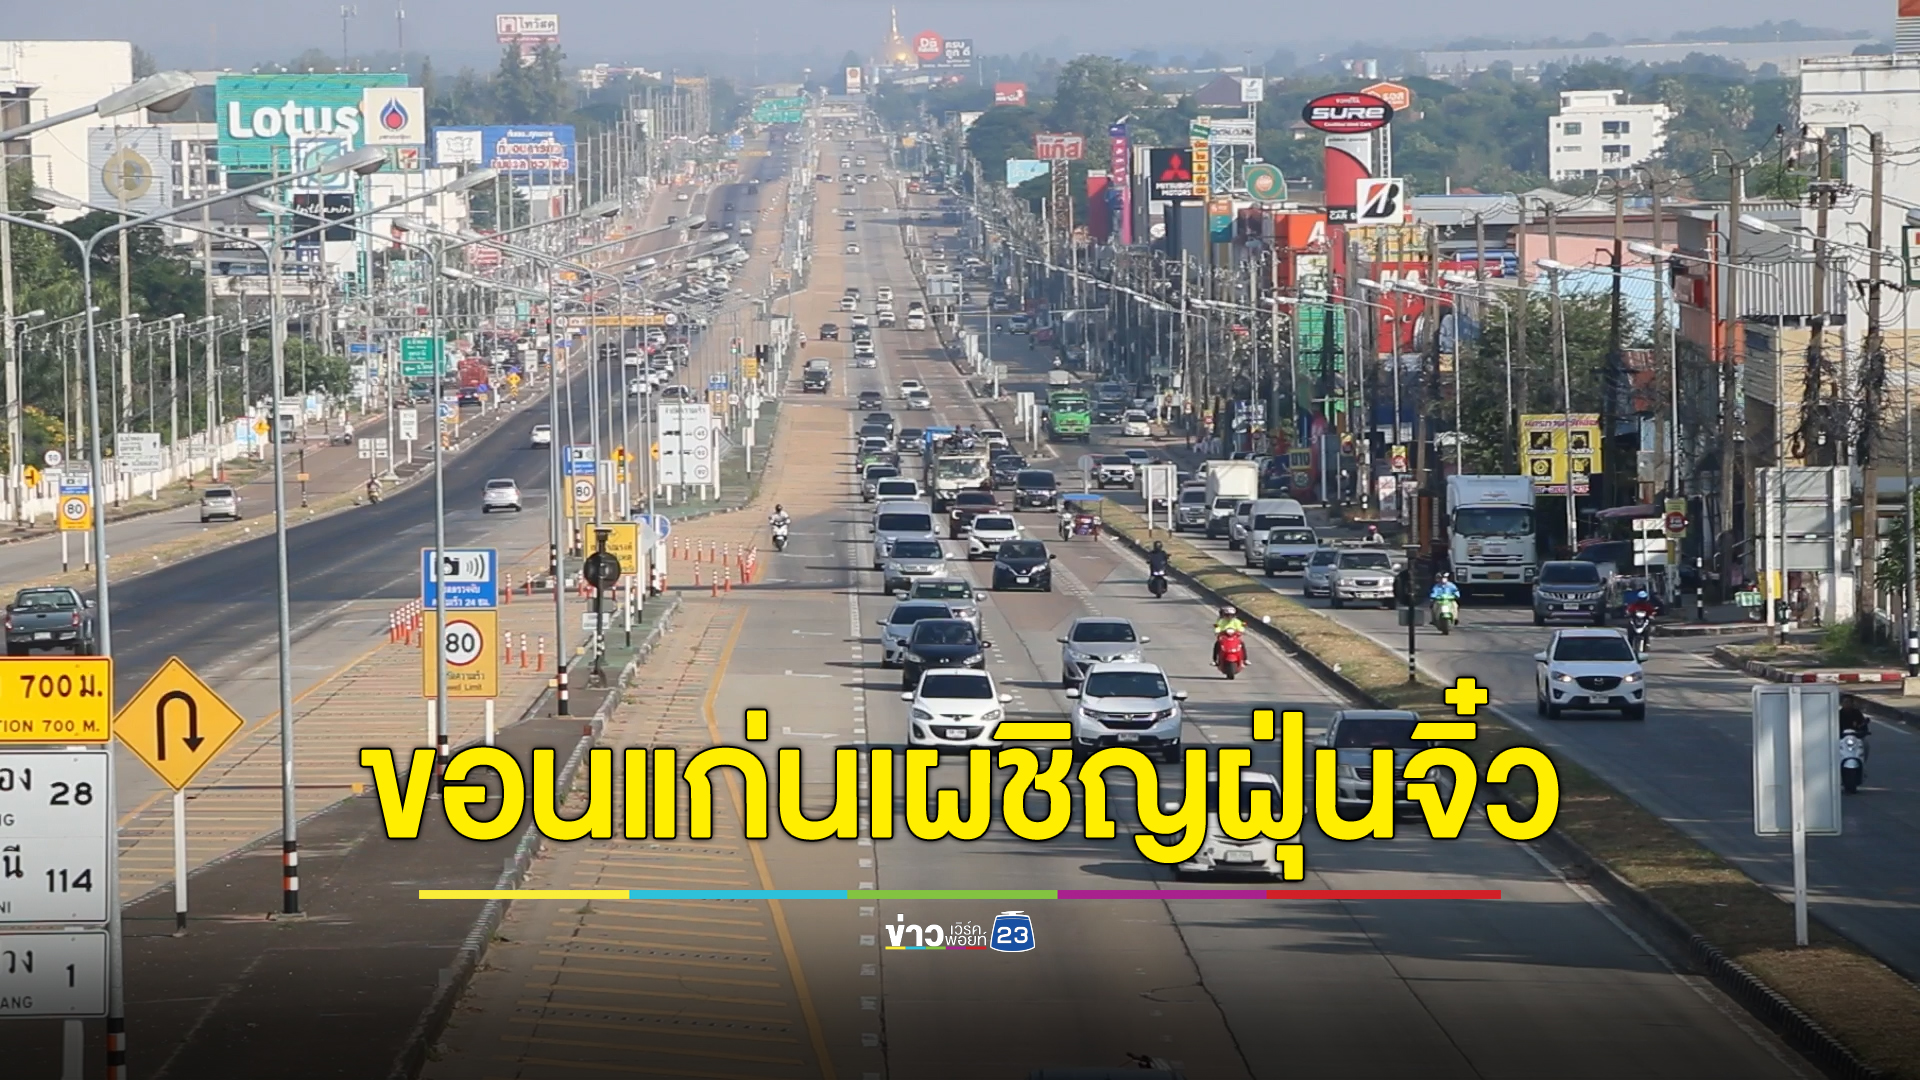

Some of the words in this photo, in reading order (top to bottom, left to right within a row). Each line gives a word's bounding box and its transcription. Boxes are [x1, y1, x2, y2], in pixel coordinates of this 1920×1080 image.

[67, 503, 83, 515] 80
[465, 598, 476, 607] 24
[446, 632, 476, 653] 80
[20, 674, 73, 699] 700
[79, 674, 103, 697] ม.
[0, 720, 33, 733] ION
[42, 720, 75, 732] 700
[83, 720, 101, 732] M.
[50, 782, 93, 806] 28
[46, 868, 92, 893] 114
[66, 963, 75, 988] 1
